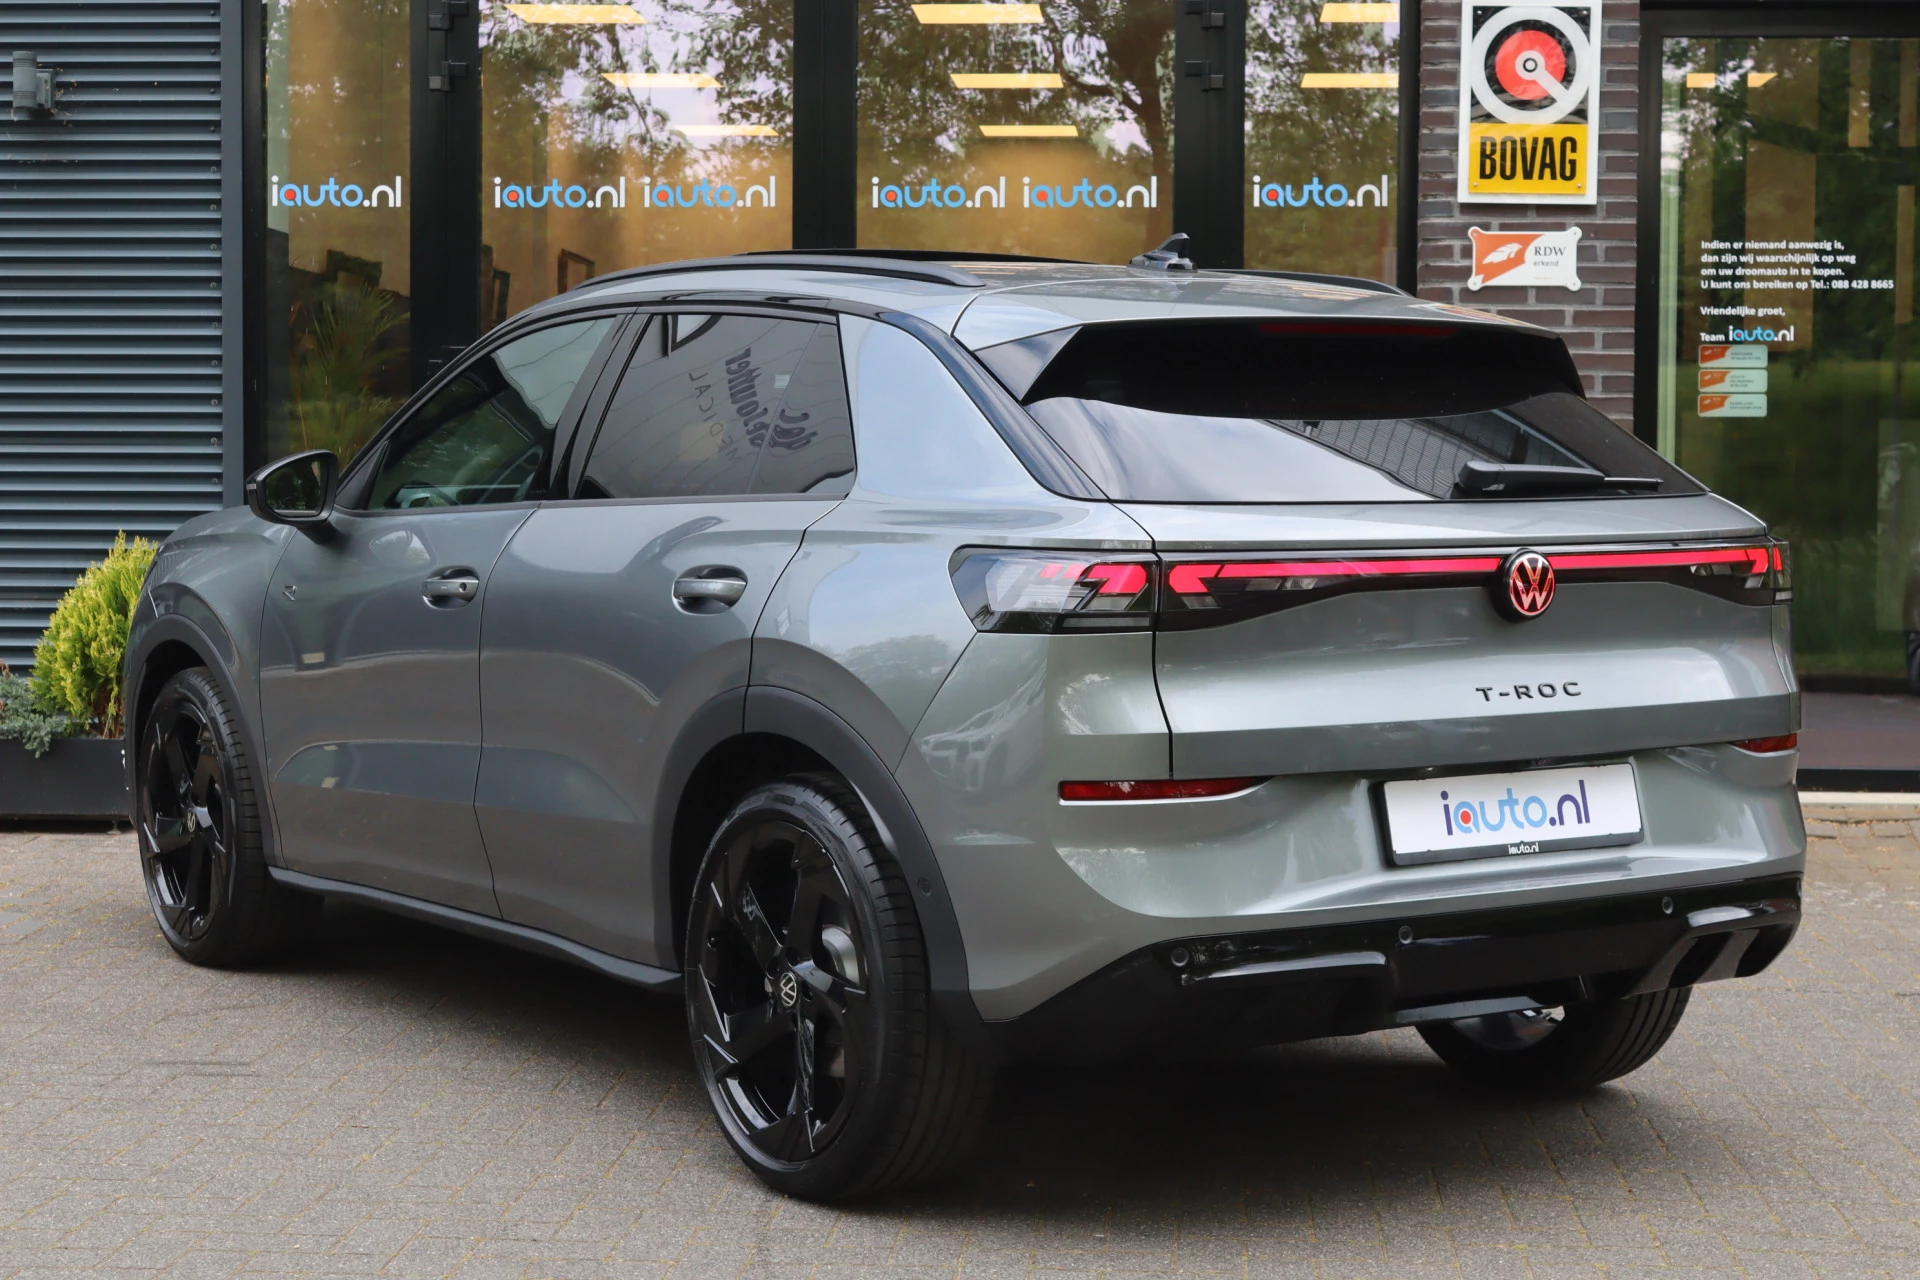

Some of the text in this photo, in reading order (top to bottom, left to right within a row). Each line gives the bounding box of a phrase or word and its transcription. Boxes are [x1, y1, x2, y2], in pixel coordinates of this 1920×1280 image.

[1479, 135, 1577, 181] BOVAG
[271, 175, 402, 208] iauto.nl
[494, 176, 625, 208] iauto.nl
[644, 176, 776, 208] iauto.nl
[872, 176, 1006, 208] iauto.nl
[1022, 176, 1157, 208] iauto.nl
[1253, 175, 1388, 208] iauto.nl
[1534, 246, 1566, 256] RDW
[1701, 240, 1731, 249] Indien
[1745, 240, 1787, 249] niemand
[1788, 240, 1832, 251] aanwezig
[1834, 240, 1845, 251] is,
[1701, 253, 1856, 264] dan zijn wij waarschijnlijk op weg
[1735, 266, 1788, 275] droomauto
[1790, 266, 1799, 275] in
[1813, 266, 1845, 277] kopen.
[1701, 280, 1894, 290] U kunt ons bereiken op Tel.: 088 428 8665
[1700, 306, 1786, 317] Vriendelijke groet,
[1700, 325, 1795, 341] Team iauto.nl
[1476, 681, 1582, 702] T-ROC
[1440, 779, 1591, 836] iauto.nl
[1508, 842, 1539, 855] iauto.nl
